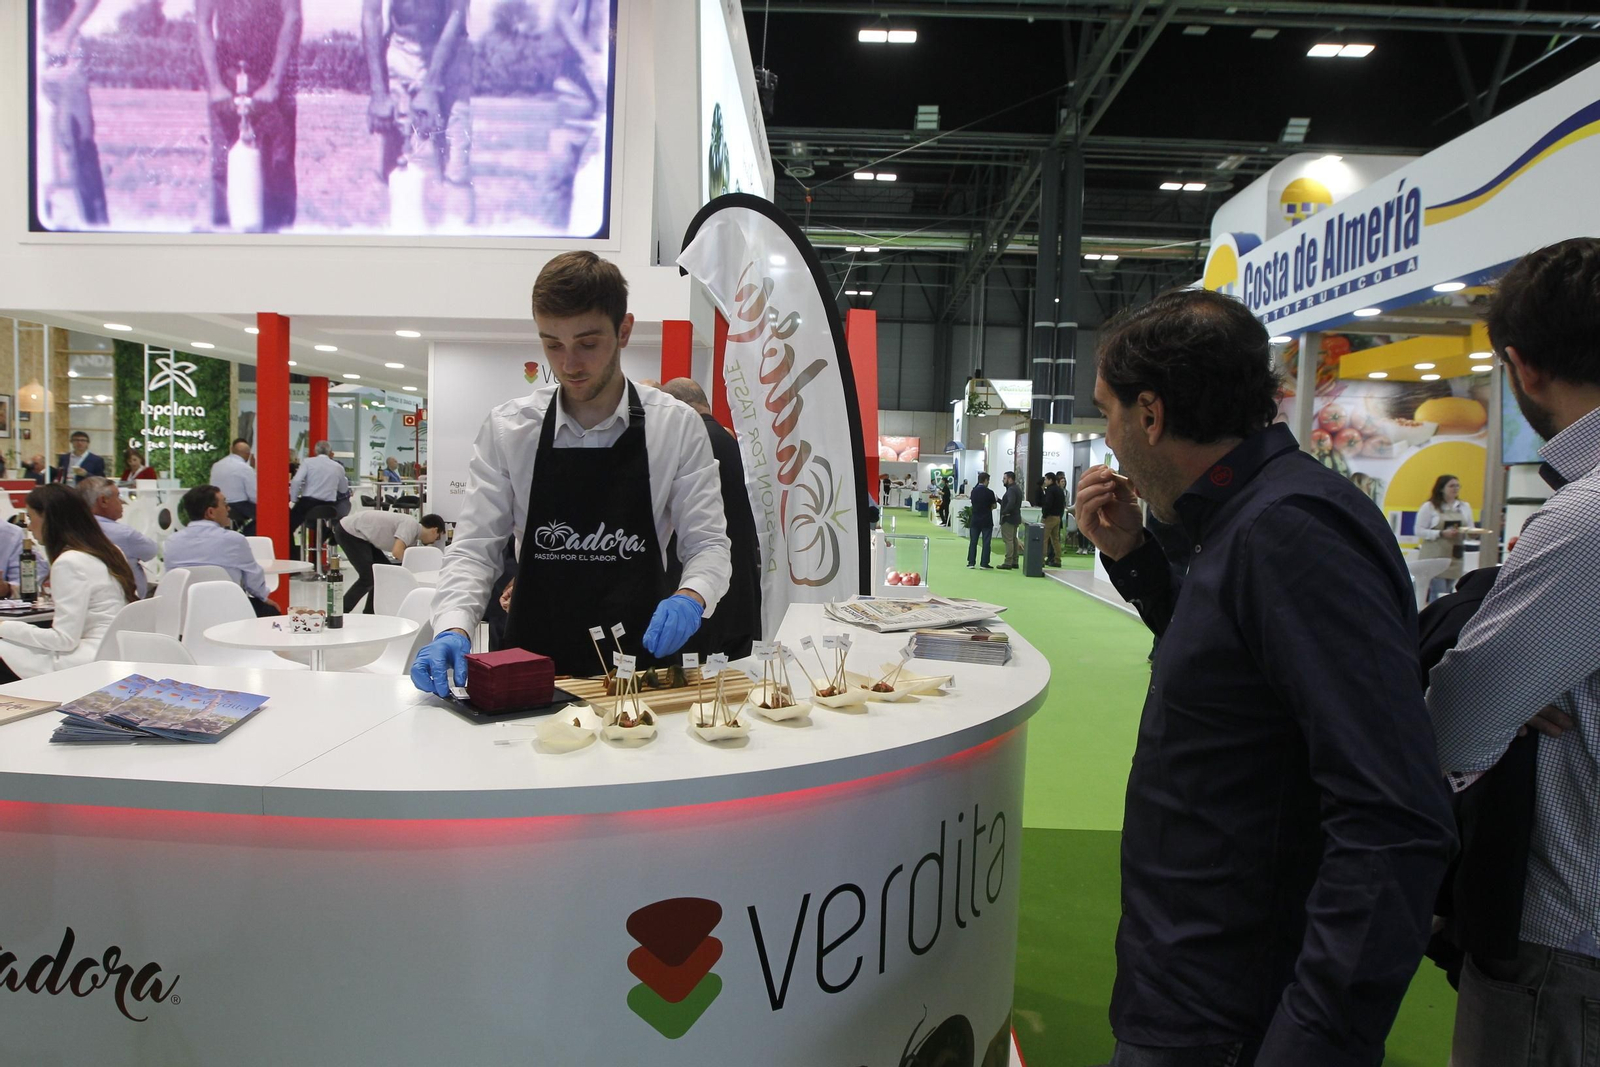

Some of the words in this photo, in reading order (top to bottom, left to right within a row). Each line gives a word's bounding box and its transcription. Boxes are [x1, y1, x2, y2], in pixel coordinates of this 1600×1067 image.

[1243, 250, 1290, 310] Costa
[1293, 232, 1318, 294] de
[1320, 177, 1422, 283] Almería
[1262, 257, 1418, 324] RTOFRUTICOLA
[534, 551, 560, 561] PASIÓN
[589, 554, 617, 562] SABOR
